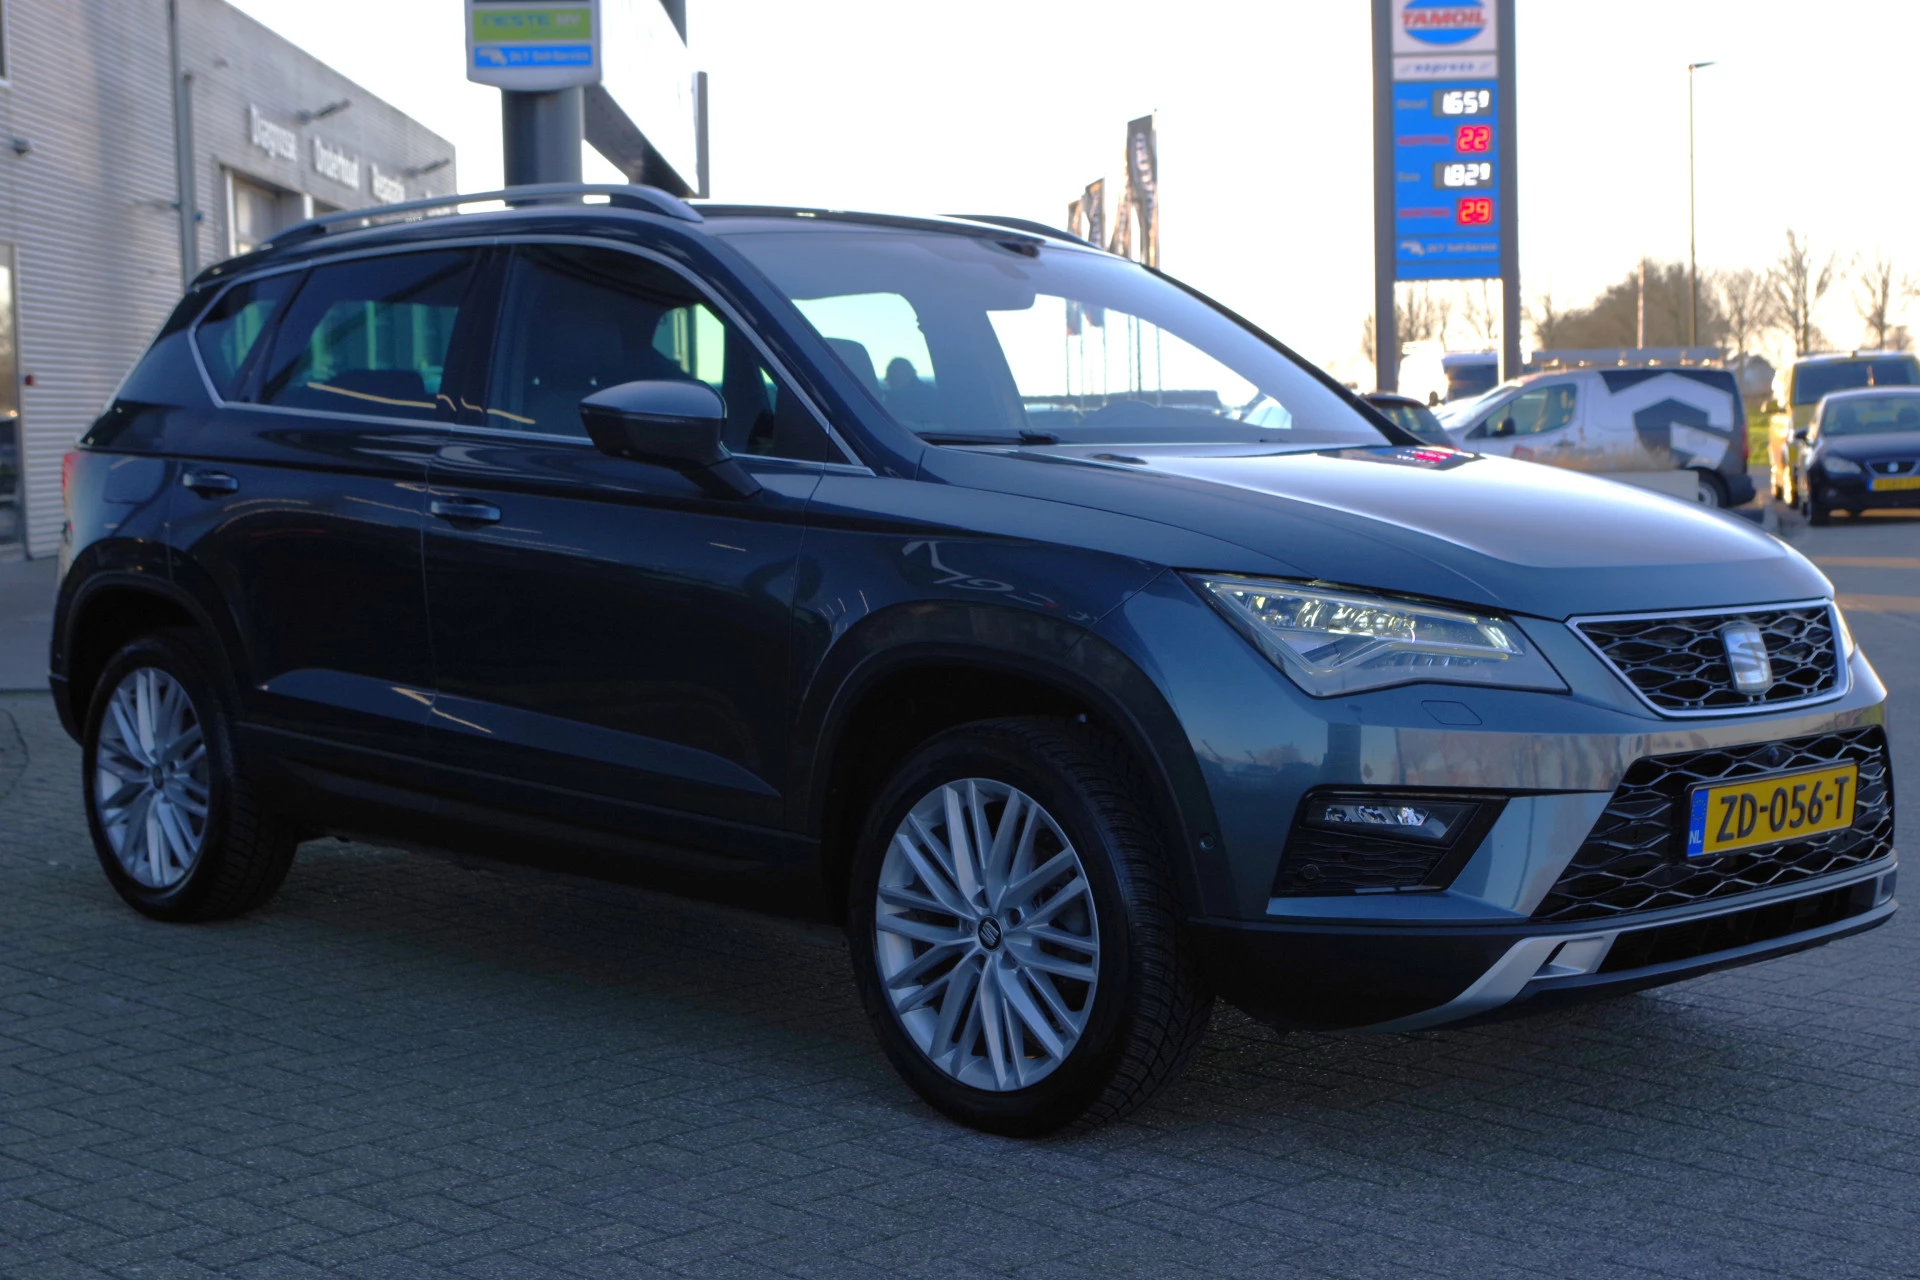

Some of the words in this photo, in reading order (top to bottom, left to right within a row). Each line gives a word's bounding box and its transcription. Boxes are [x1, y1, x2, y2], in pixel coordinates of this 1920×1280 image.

[1401, 8, 1487, 26] TAMOIL
[1457, 125, 1491, 152] 22
[1458, 197, 1492, 225] 29
[1716, 776, 1849, 842] ZD-056-T
[1689, 830, 1702, 844] NL
